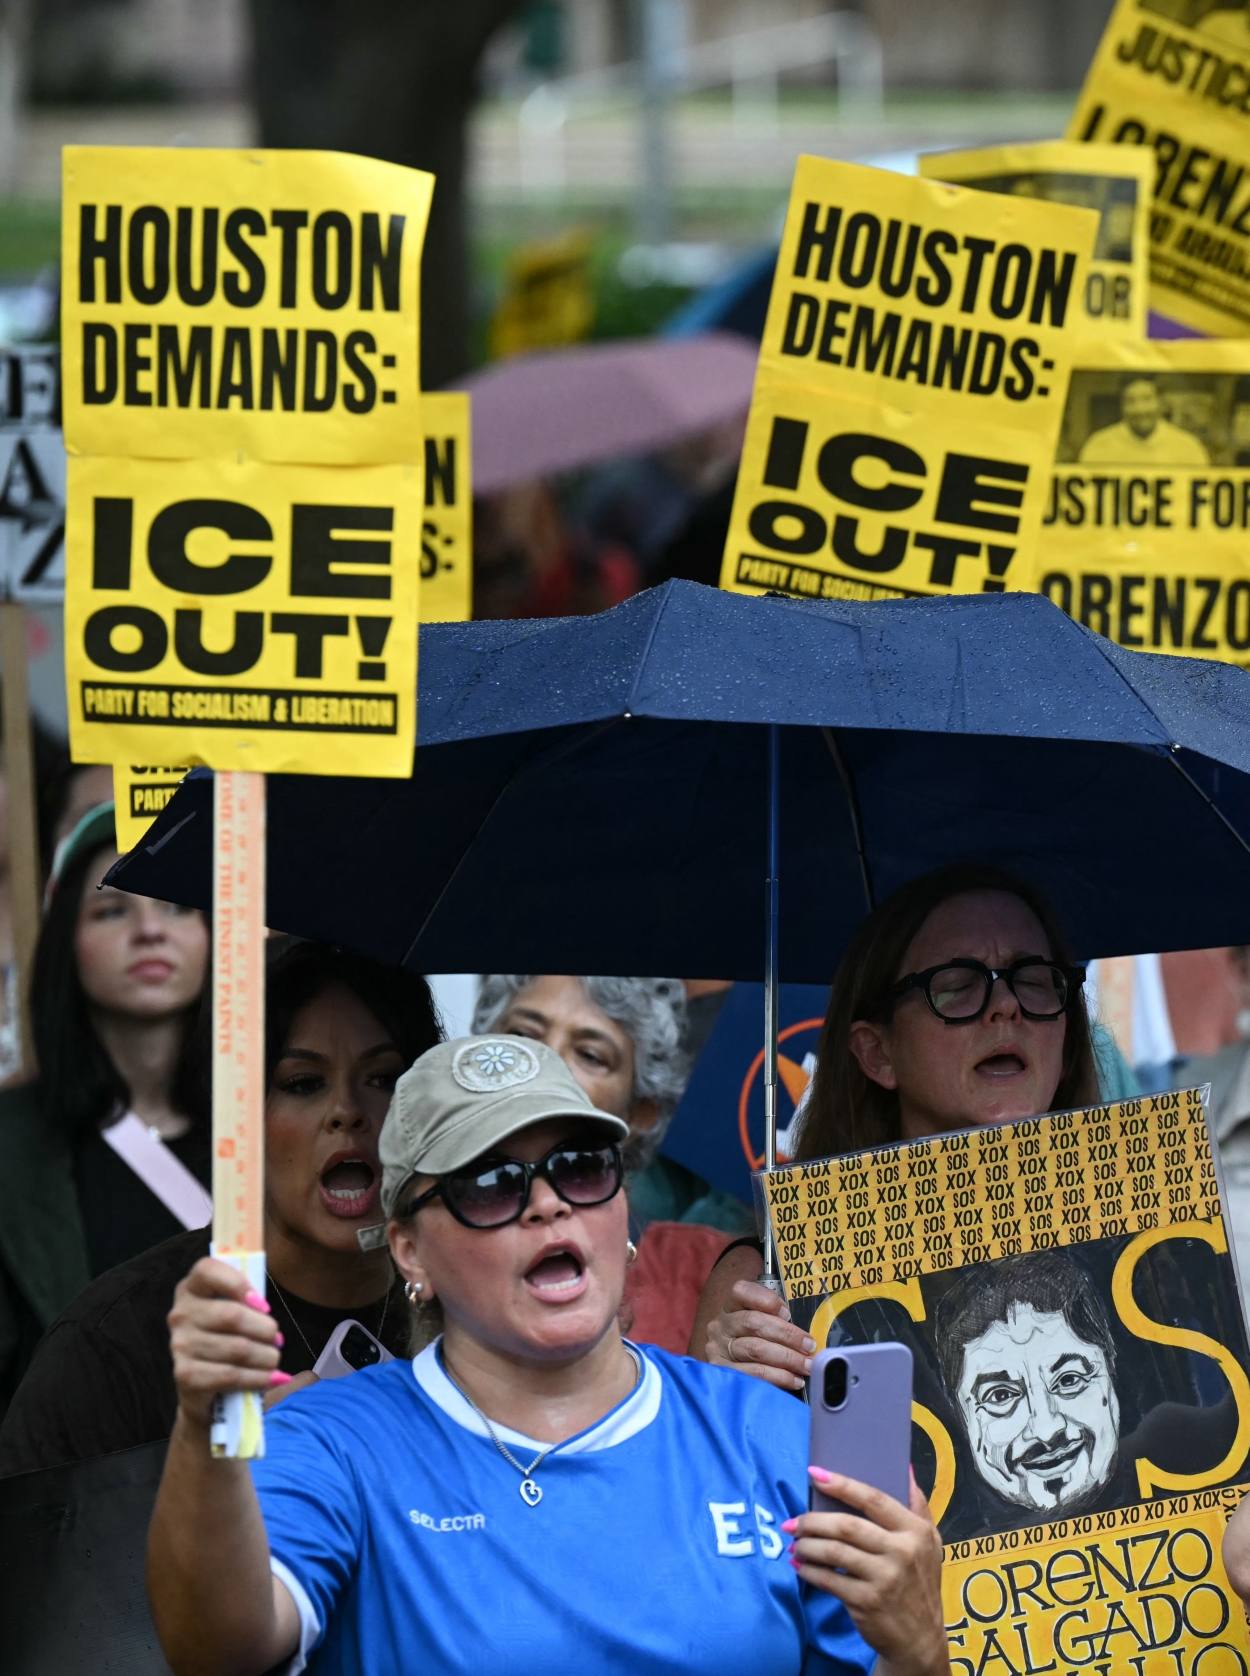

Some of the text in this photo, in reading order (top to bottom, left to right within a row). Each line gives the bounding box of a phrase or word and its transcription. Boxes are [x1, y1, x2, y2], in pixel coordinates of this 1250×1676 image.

[79, 203, 406, 312] HOUSTON
[792, 202, 1077, 328] HOUSTON
[1086, 271, 1131, 321] OR
[82, 322, 398, 414] DEMANDS:
[781, 292, 1055, 401] DEMANDS:
[762, 416, 1030, 535] ICE
[92, 496, 395, 600] ICE
[739, 557, 790, 587] PARTY
[790, 568, 821, 594] FOR
[748, 500, 1017, 593] OUT!
[83, 604, 394, 681] OUT!
[84, 687, 394, 727] PARTY FOR SOCIALISM & LIBERATION
[133, 788, 180, 813] PART
[770, 1185, 798, 1204] XOX
[807, 1179, 829, 1198] SOS
[839, 1171, 868, 1191] XOX
[876, 1165, 898, 1184] SOS
[907, 1158, 936, 1178] XOX
[947, 1152, 967, 1170] SOS
[978, 1145, 1008, 1164] XOX
[1018, 1139, 1039, 1157] SOS
[1049, 1130, 1079, 1150] XOX
[1088, 1124, 1110, 1142] SOS
[1119, 1117, 1148, 1136] XOX
[1157, 1110, 1178, 1129] SOS
[777, 1204, 797, 1222] SOS
[807, 1197, 837, 1217] XOX
[846, 1191, 868, 1209] SOS
[877, 1183, 906, 1203] XOX
[915, 1178, 936, 1196] SOS
[946, 1169, 975, 1190] XOX
[985, 1164, 1007, 1182] SOS
[1018, 1156, 1046, 1176] XOX
[1056, 1151, 1078, 1169] SOS
[1088, 1142, 1117, 1162] XOX
[1126, 1136, 1147, 1154] SOS
[1157, 1129, 1185, 1148] XOX
[777, 1223, 806, 1242] XOX
[815, 1217, 837, 1236] SOS
[847, 1209, 875, 1228] XOX
[884, 1203, 906, 1221] SOS
[915, 1195, 944, 1215] XOX
[953, 1189, 974, 1208] SOS
[985, 1182, 1014, 1201] XOX
[1024, 1175, 1045, 1194] SOS
[1055, 1168, 1084, 1187] XOX
[1094, 1162, 1115, 1180] SOS
[1126, 1154, 1155, 1173] XOX
[1164, 1149, 1185, 1167] SOS
[409, 1509, 485, 1533] SELECTA
[709, 1501, 784, 1561] ES
[951, 1542, 969, 1560] XO
[975, 1537, 994, 1554] XO
[999, 1532, 1017, 1549] XO
[1024, 1526, 1042, 1544] XO
[1049, 1521, 1067, 1539] XO
[1073, 1517, 1091, 1534] XO
[1097, 1511, 1115, 1529] XO
[1120, 1507, 1138, 1524] XO
[1145, 1502, 1163, 1520] XO
[1169, 1497, 1187, 1515] XO
[1193, 1490, 1219, 1510] XOX
